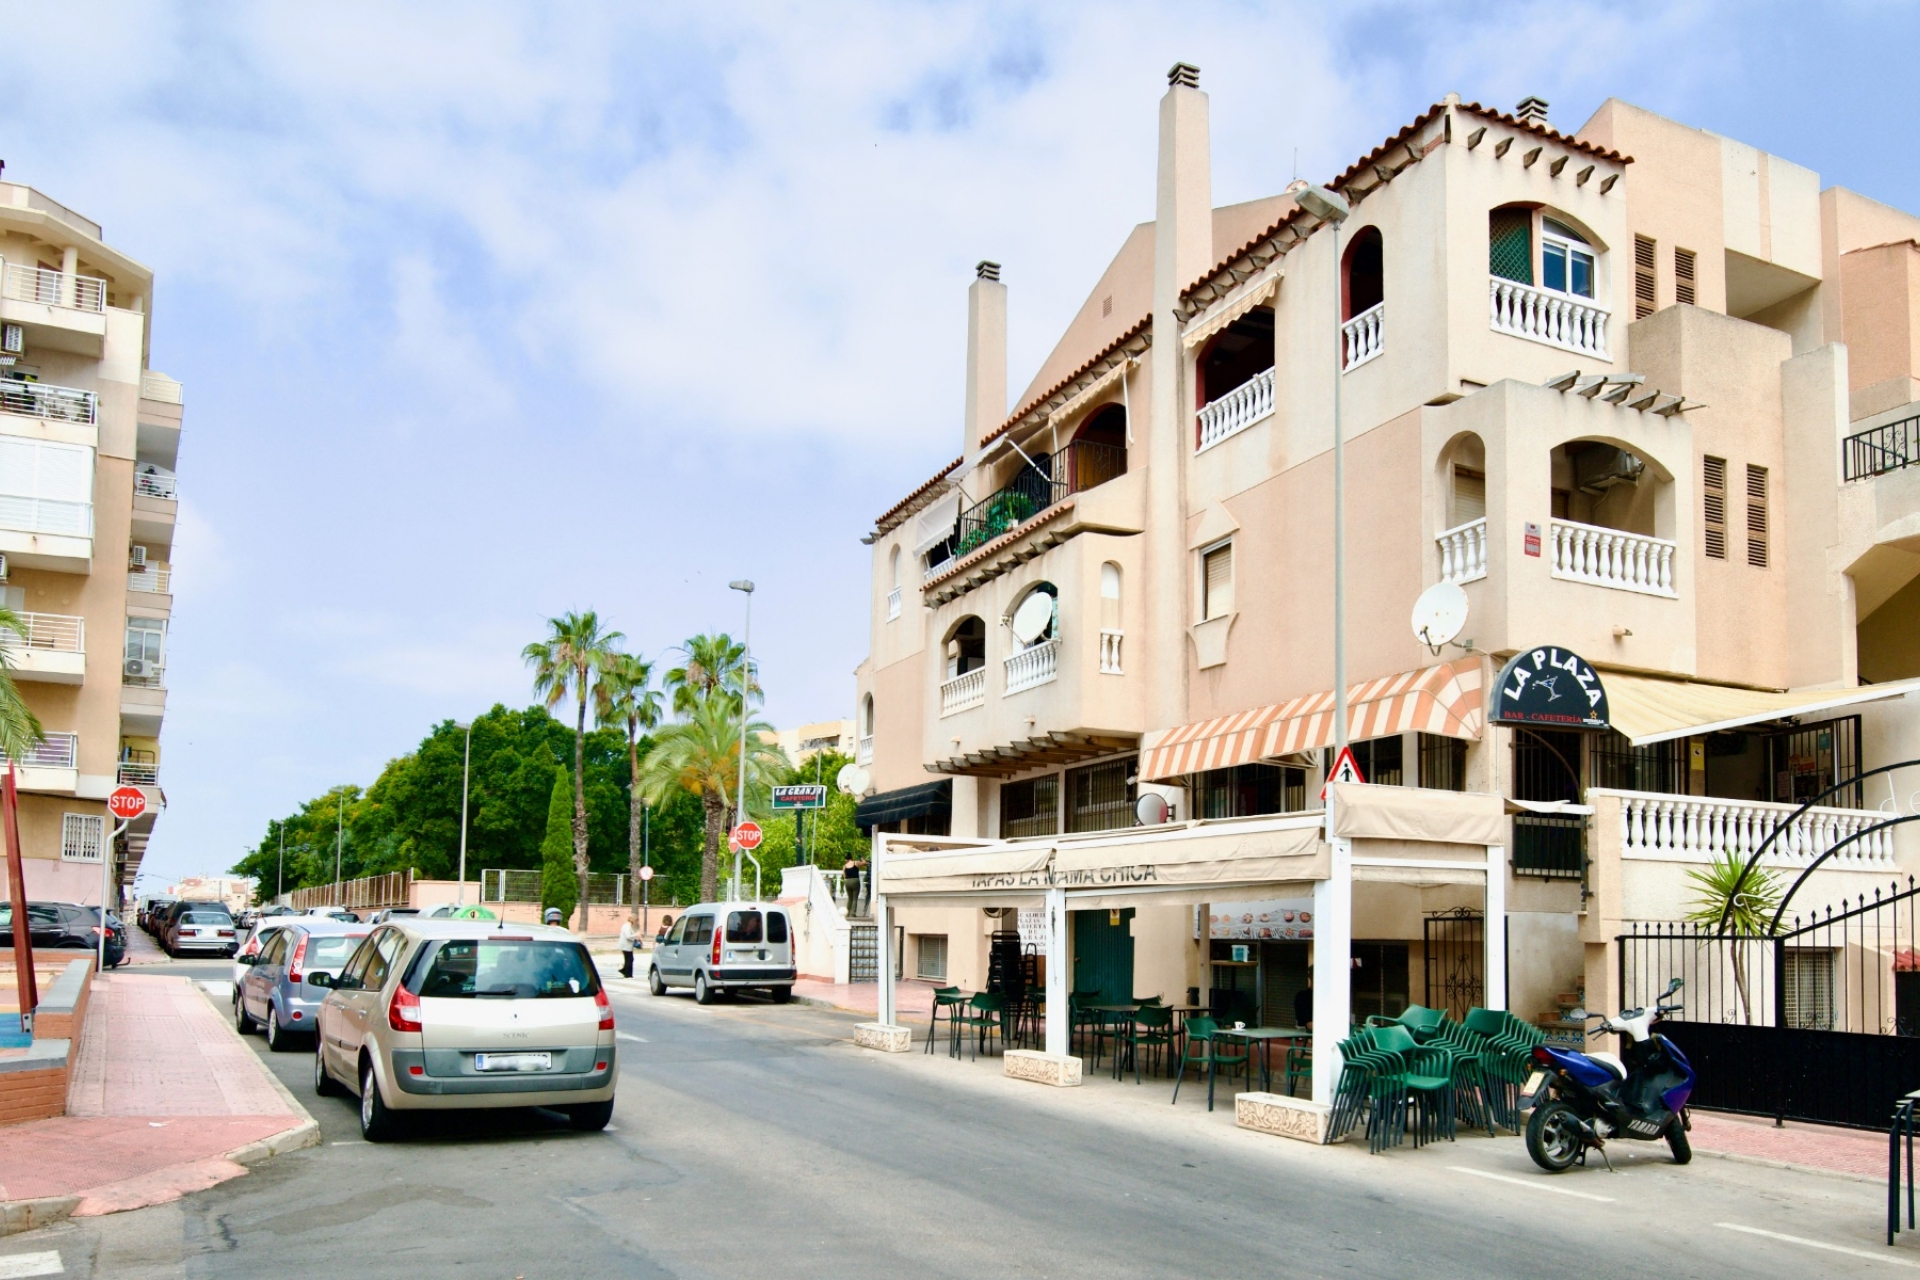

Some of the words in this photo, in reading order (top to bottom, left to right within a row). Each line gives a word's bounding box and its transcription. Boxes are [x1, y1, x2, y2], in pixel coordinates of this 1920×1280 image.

[1503, 666, 1532, 701] LA
[1531, 648, 1602, 708] PLAZA
[1504, 710, 1525, 720] BAR
[1531, 712, 1583, 724] CAFETERÍA
[775, 788, 787, 796] LA
[111, 795, 145, 809] STOP
[737, 830, 761, 841] STOP
[972, 873, 1015, 888] TAPAS
[1019, 870, 1039, 886] LA
[1627, 1119, 1661, 1136] YAMAHA
